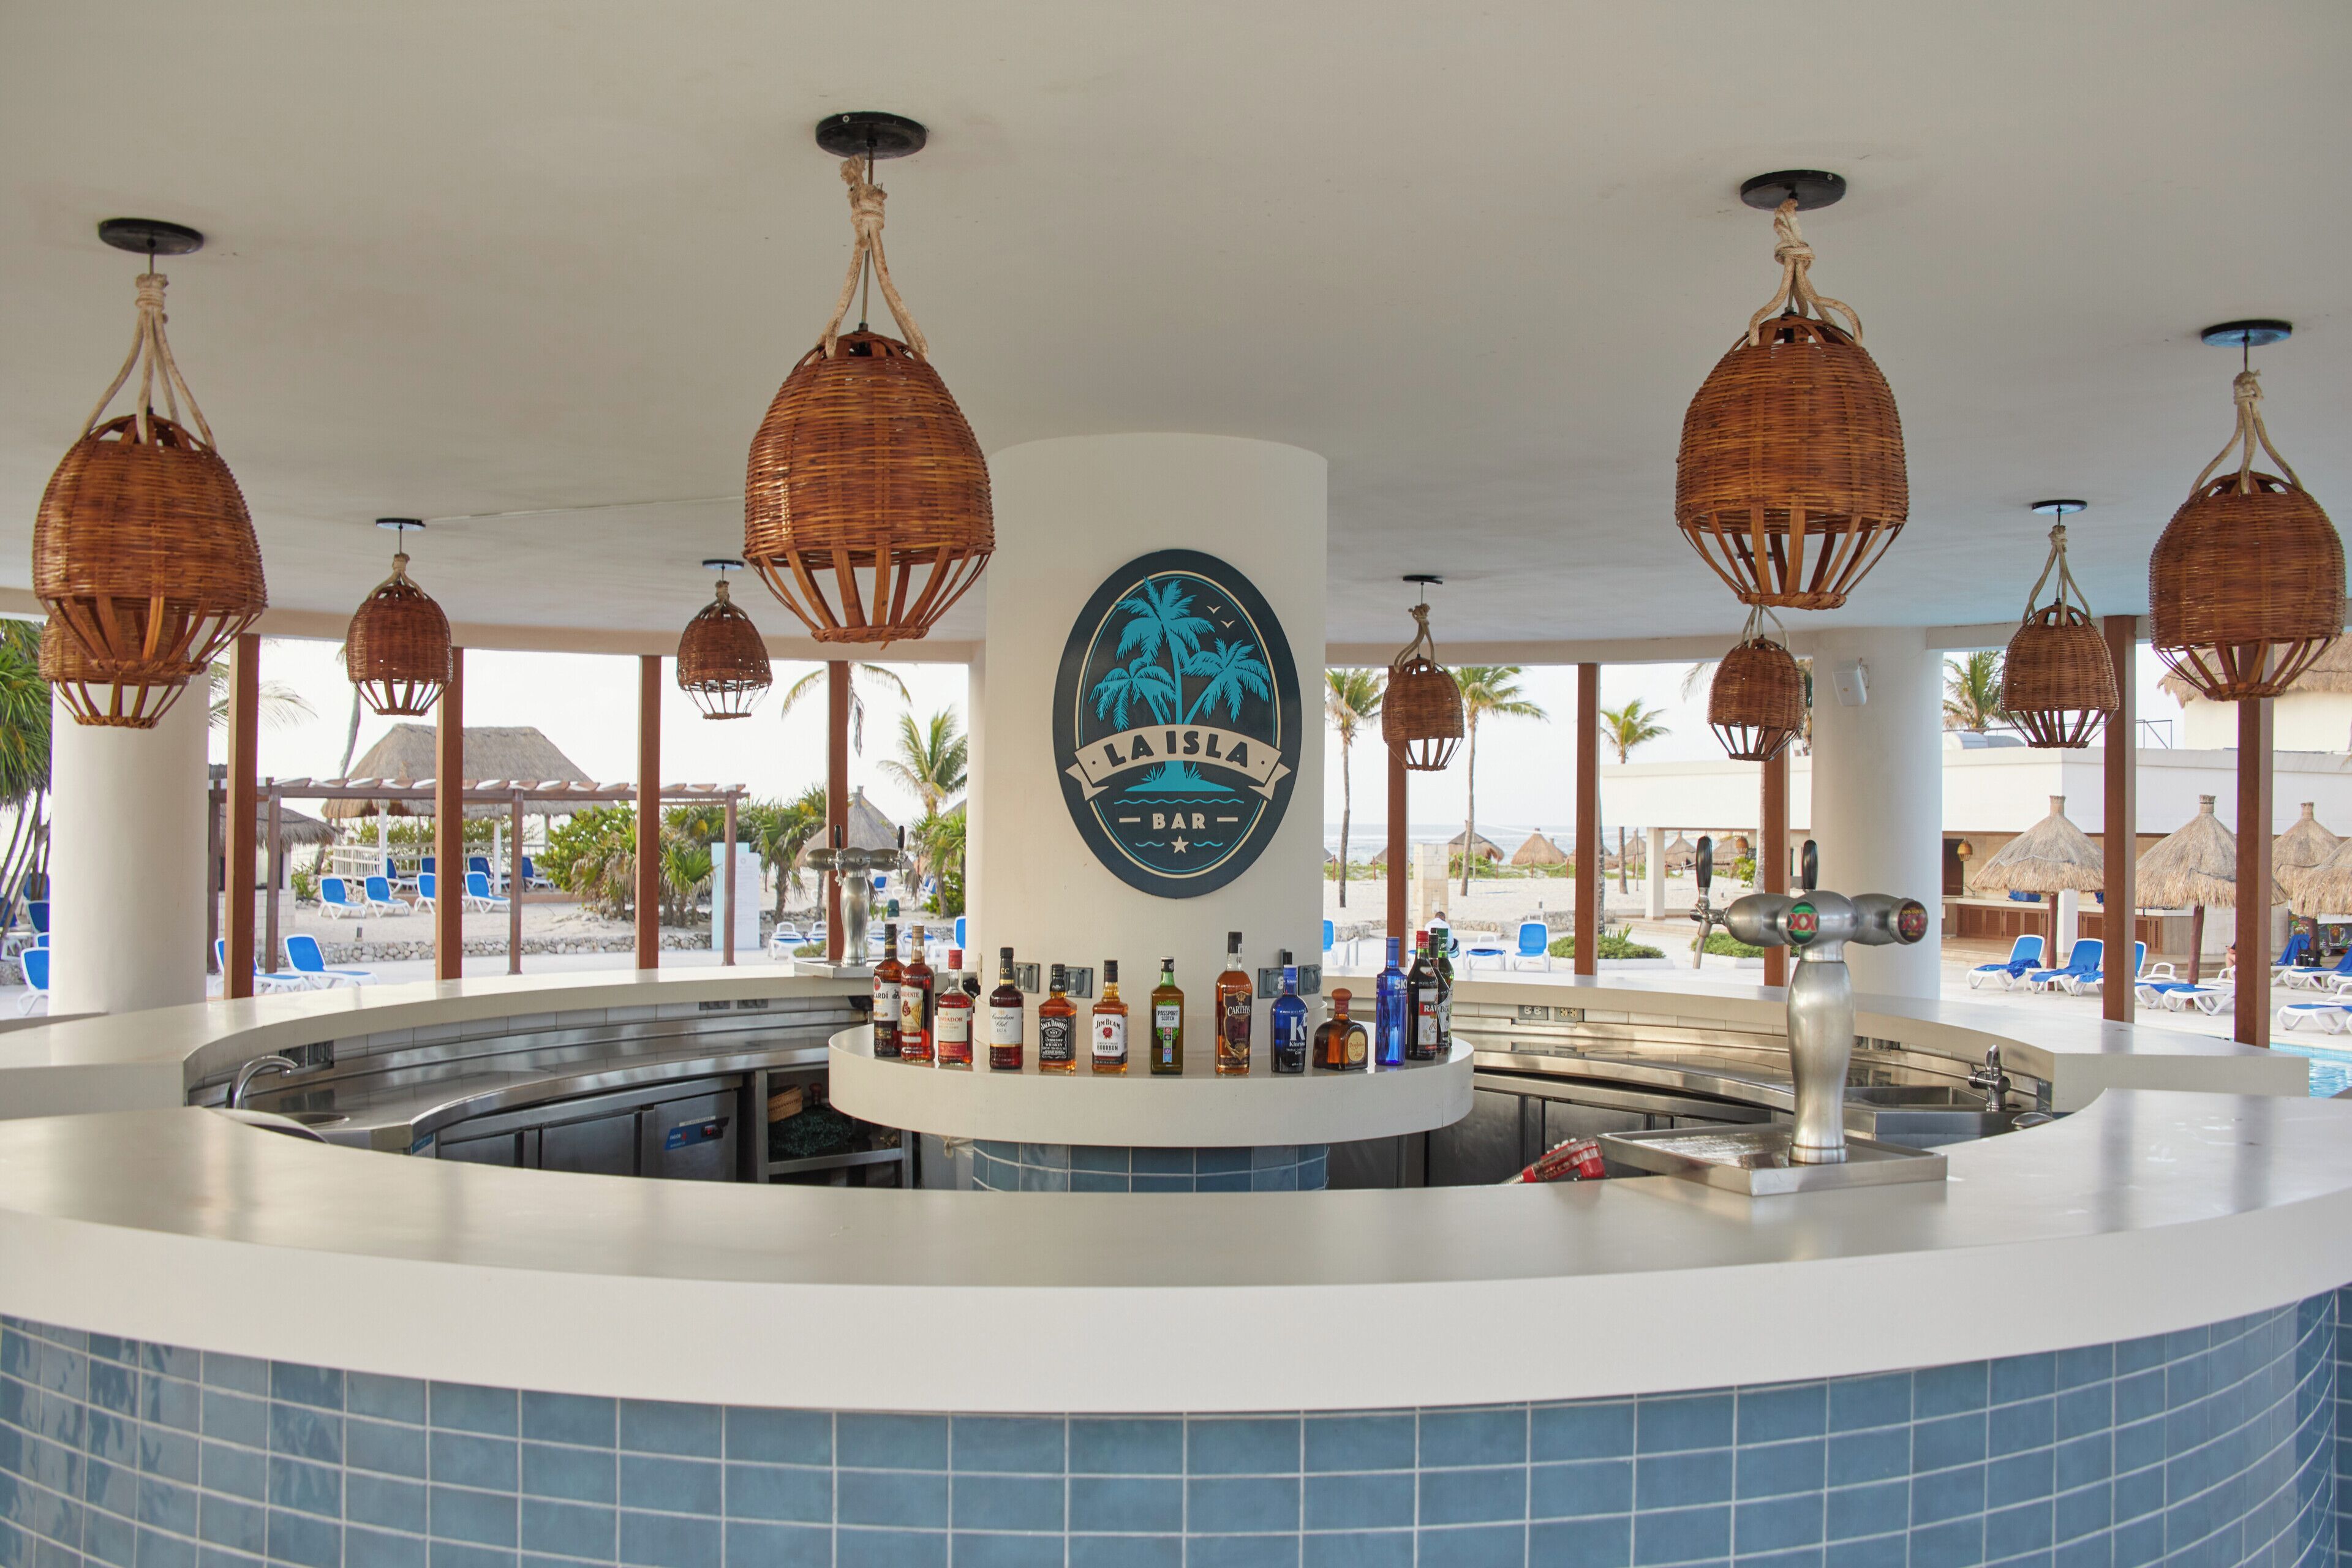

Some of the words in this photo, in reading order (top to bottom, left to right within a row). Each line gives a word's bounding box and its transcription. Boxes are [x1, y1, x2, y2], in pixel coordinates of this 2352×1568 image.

[1104, 734, 1155, 767] LA
[1166, 731, 1248, 768] ISLA
[1153, 813, 1205, 830] BAR
[1788, 912, 1818, 932] XX
[1041, 1021, 1051, 1030] JACK
[1095, 1020, 1105, 1029] JIM
[1106, 1018, 1120, 1030] BEAM
[1290, 1016, 1306, 1041] K
